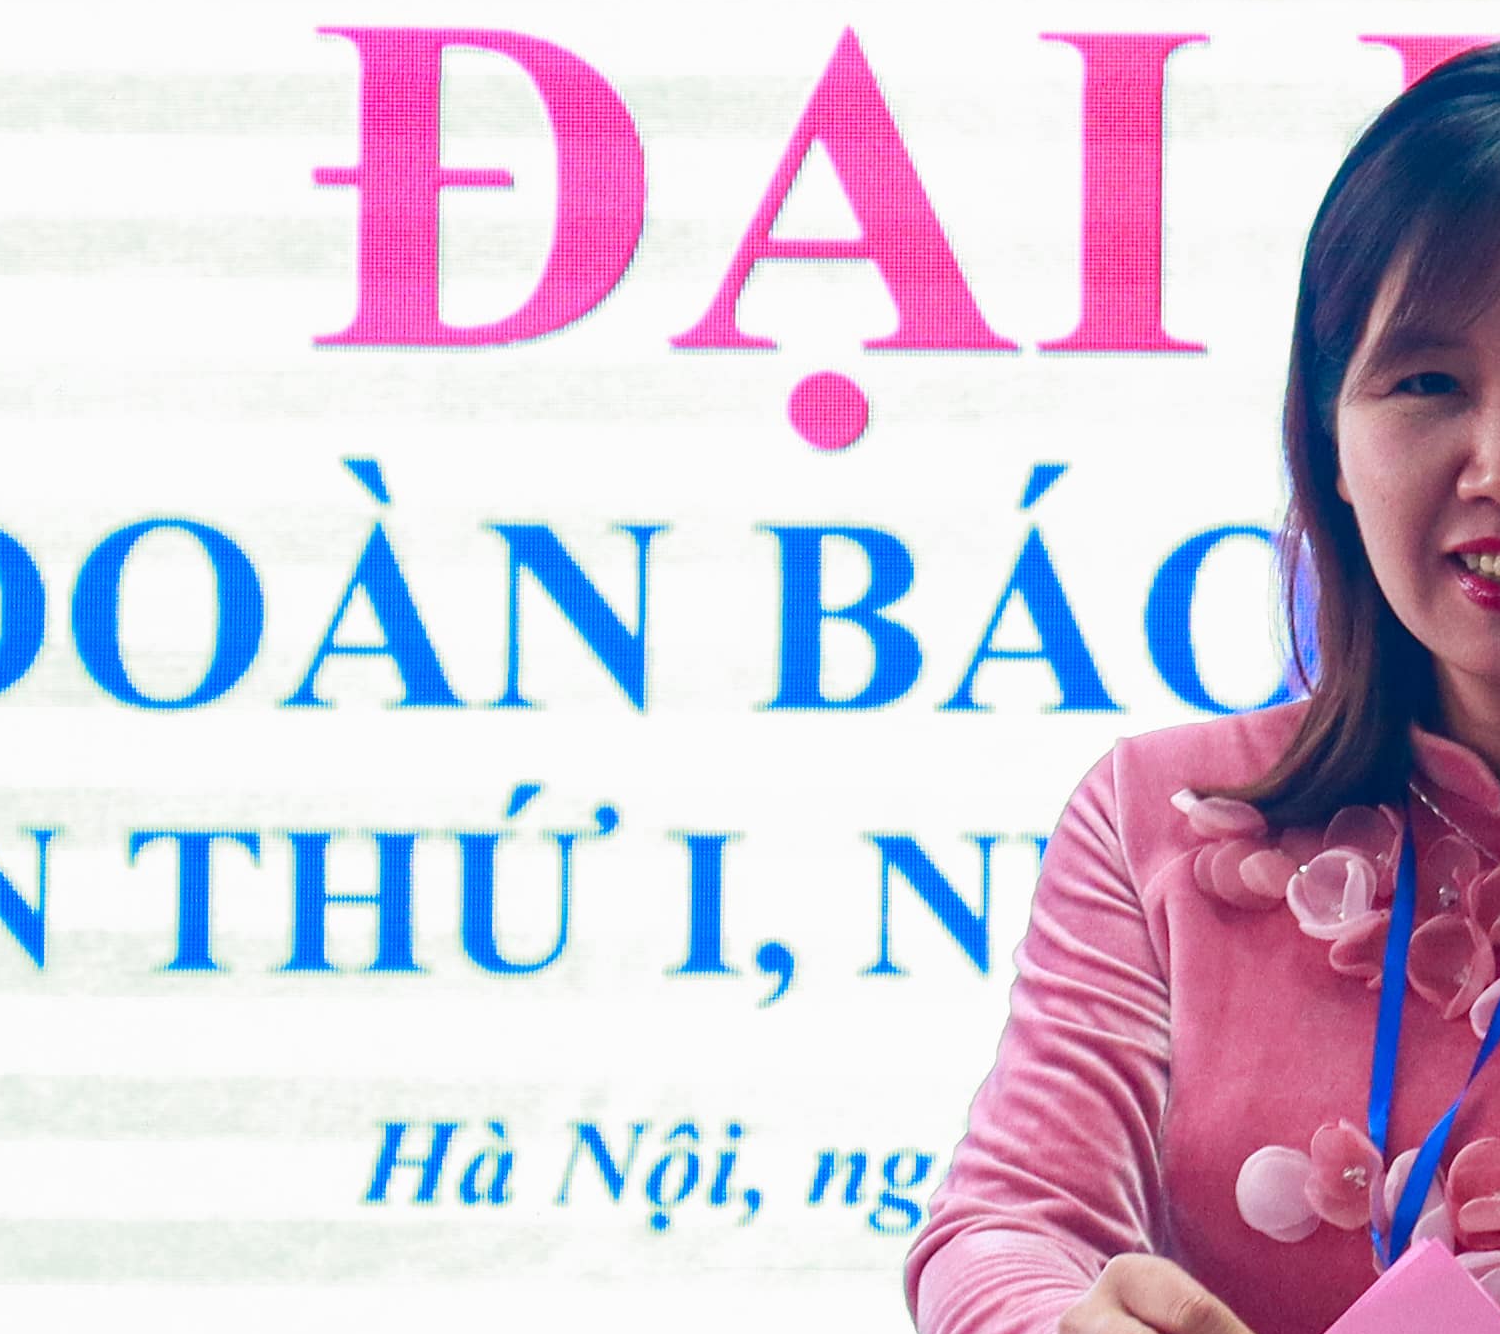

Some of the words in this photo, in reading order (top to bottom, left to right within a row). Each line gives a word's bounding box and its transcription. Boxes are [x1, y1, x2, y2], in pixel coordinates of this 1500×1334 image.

[311, 26, 1210, 452] ĐẠI
[764, 463, 1322, 716] BÁO
[129, 782, 624, 977] THỨ
[675, 832, 797, 1005] I,
[364, 1121, 516, 1208] Hà
[560, 1121, 764, 1235] Nội,
[808, 1151, 935, 1235] ng
